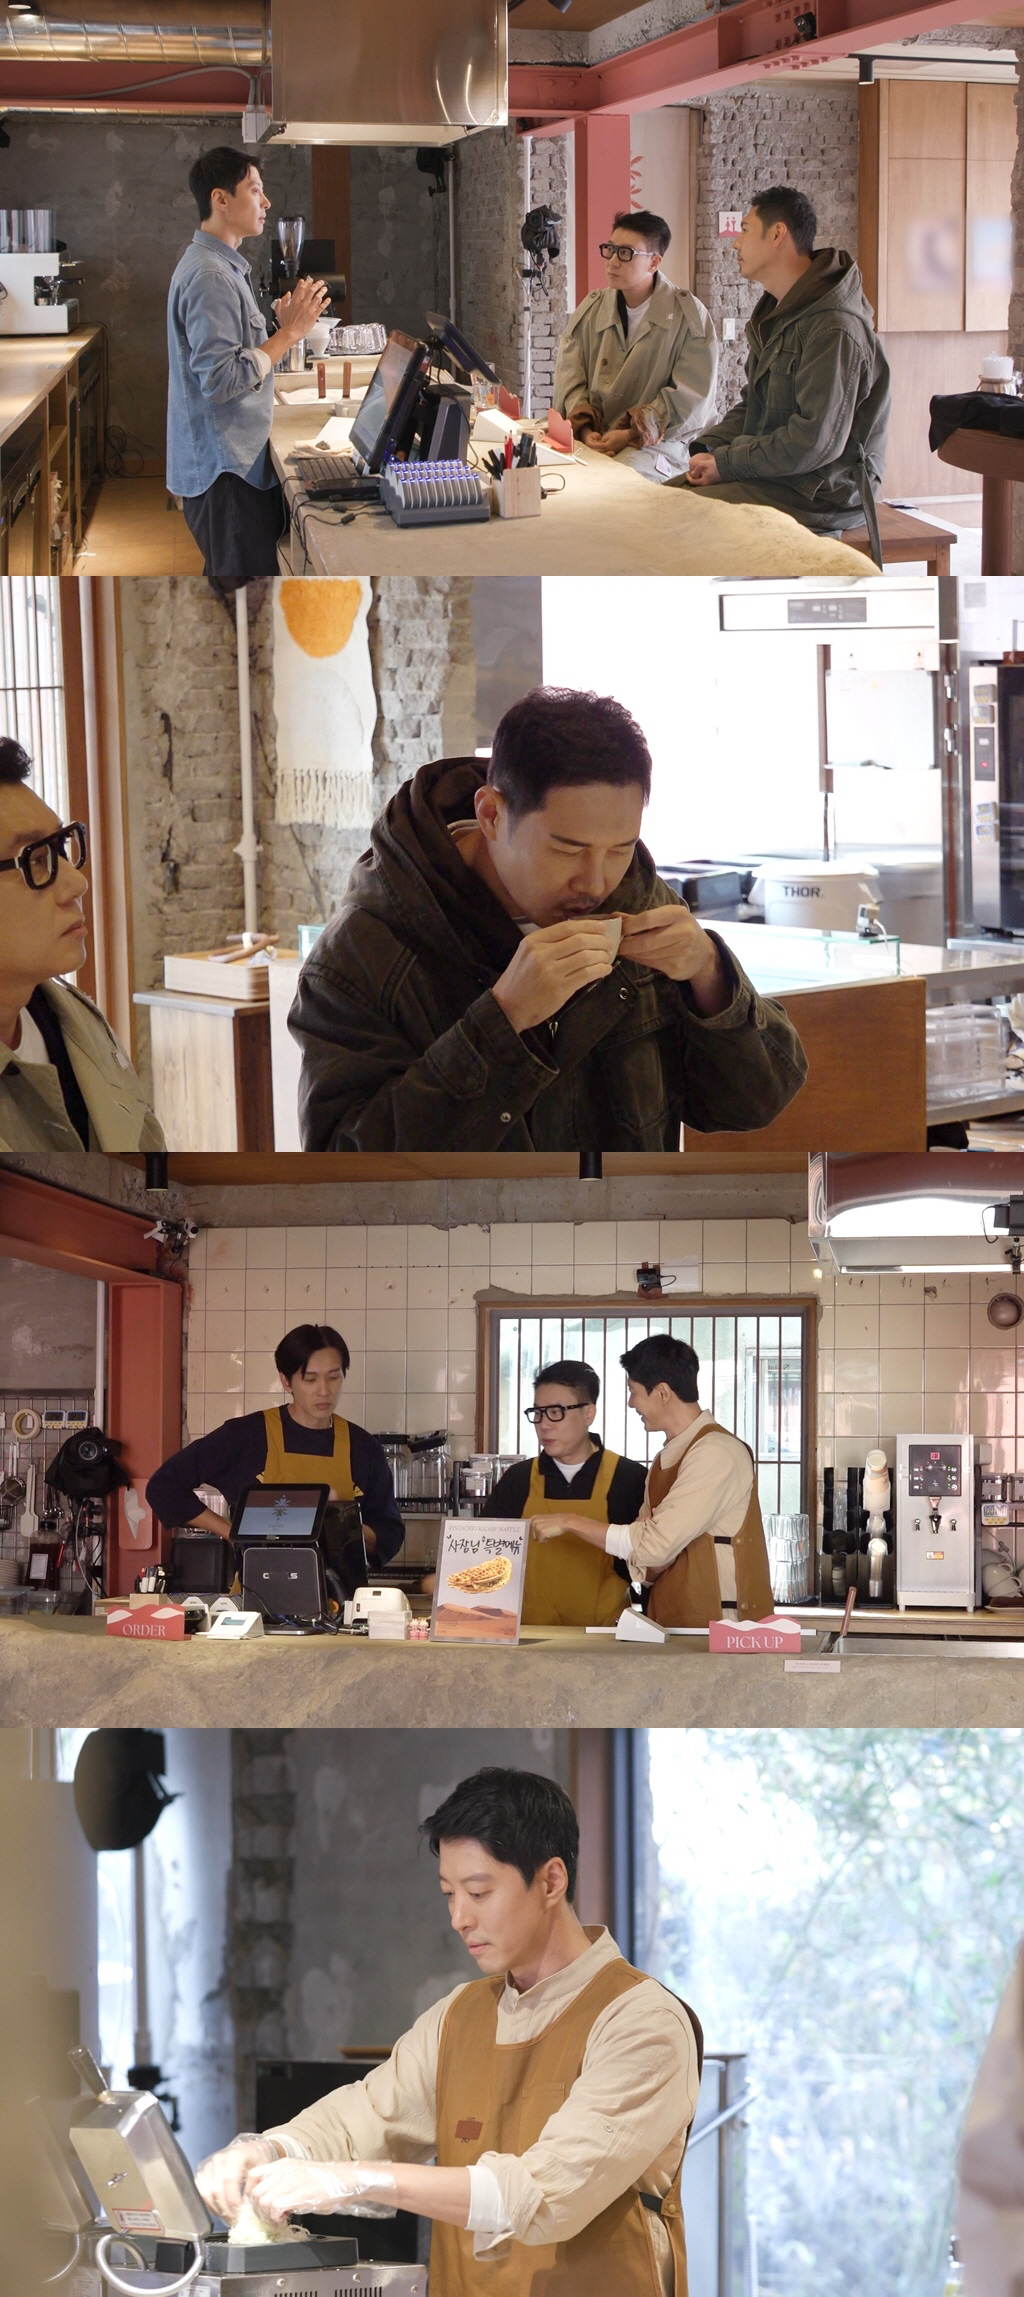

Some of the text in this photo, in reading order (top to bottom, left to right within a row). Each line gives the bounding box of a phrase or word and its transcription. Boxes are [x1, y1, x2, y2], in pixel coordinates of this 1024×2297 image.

[783, 886, 821, 898] THOR
[122, 1623, 167, 1638] ORDER
[726, 1636, 784, 1649] PICK UP
